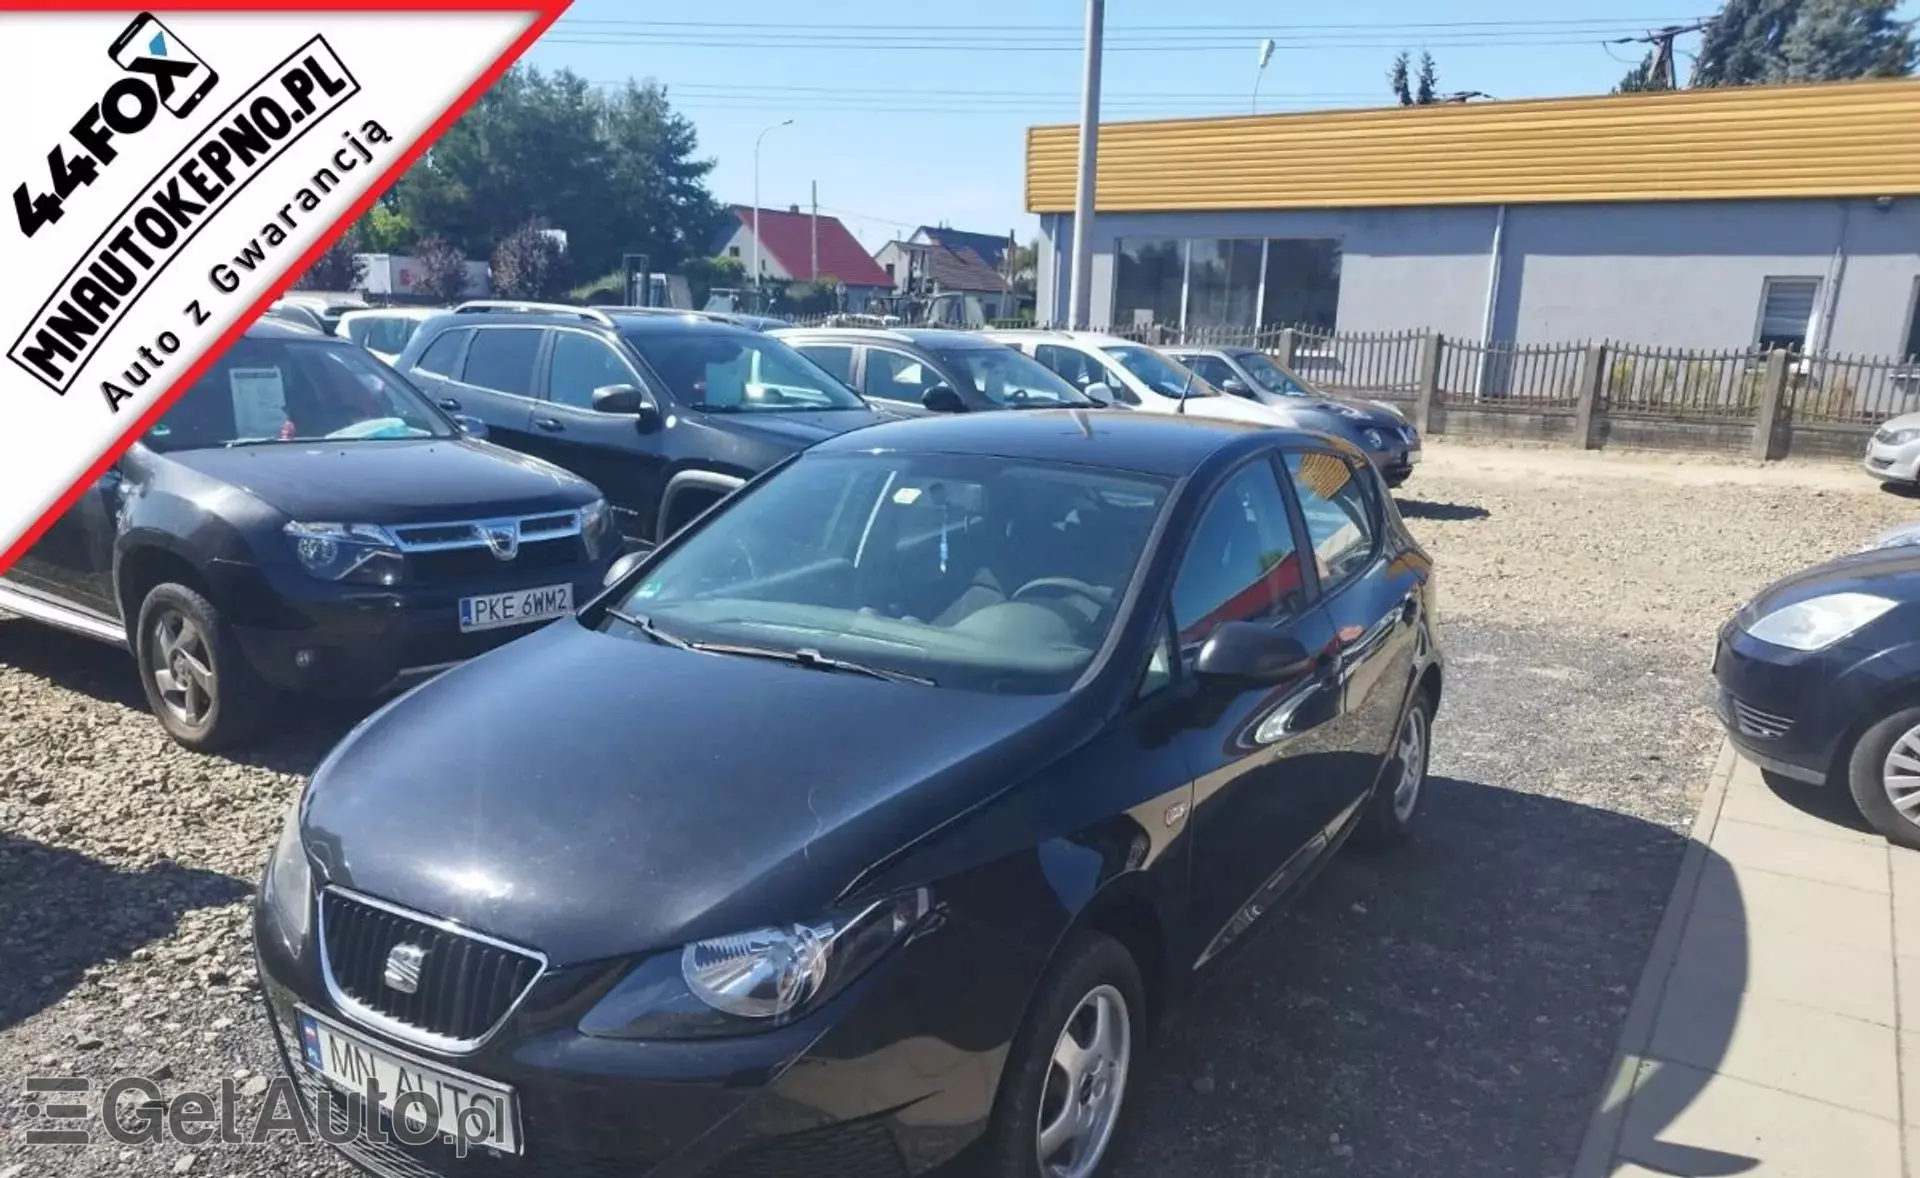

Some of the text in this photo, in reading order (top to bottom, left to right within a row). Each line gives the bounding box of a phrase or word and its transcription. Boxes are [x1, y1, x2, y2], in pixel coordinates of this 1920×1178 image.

[475, 596, 515, 621] PKE
[521, 588, 567, 616] 6WM2
[329, 1033, 376, 1086] MN
